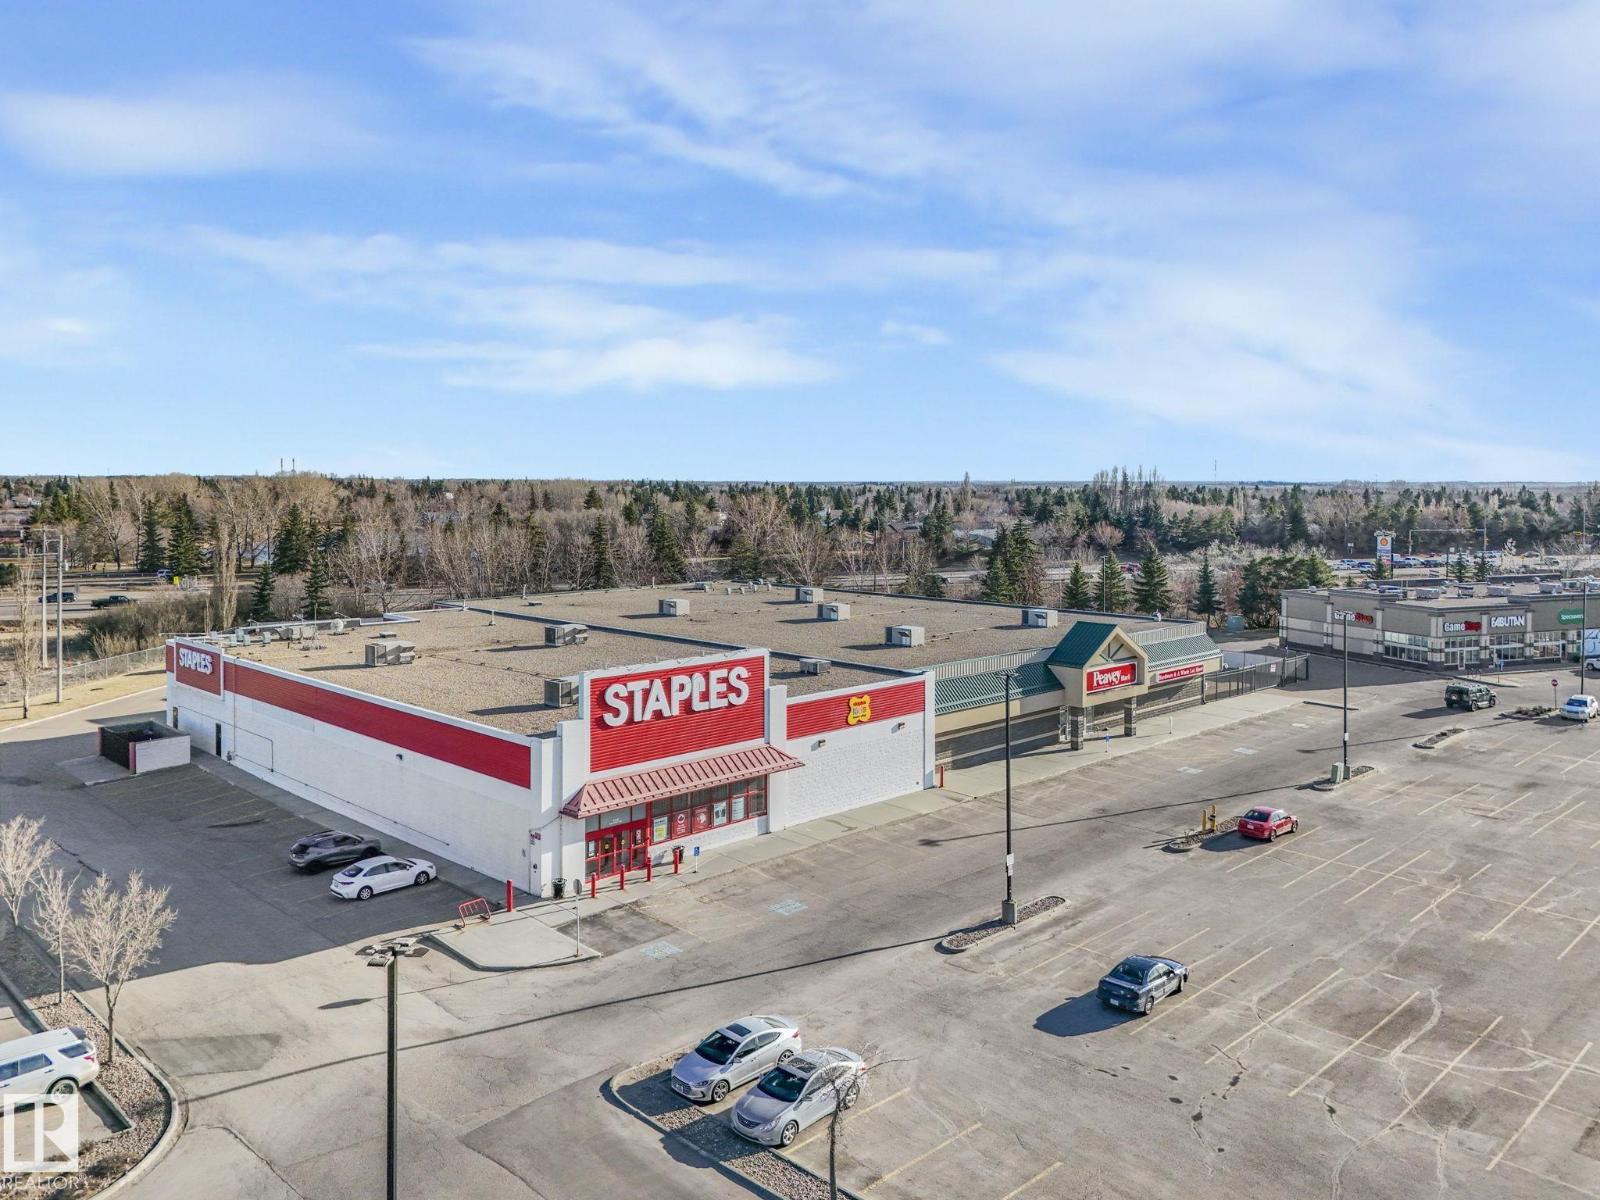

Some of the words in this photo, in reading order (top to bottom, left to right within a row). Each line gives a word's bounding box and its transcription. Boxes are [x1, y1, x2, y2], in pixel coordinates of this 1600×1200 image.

[1490, 615, 1525, 628] FABUTAN
[179, 647, 213, 675] STAPLES
[1093, 670, 1121, 687] Peavey
[603, 666, 750, 727] STAPLES
